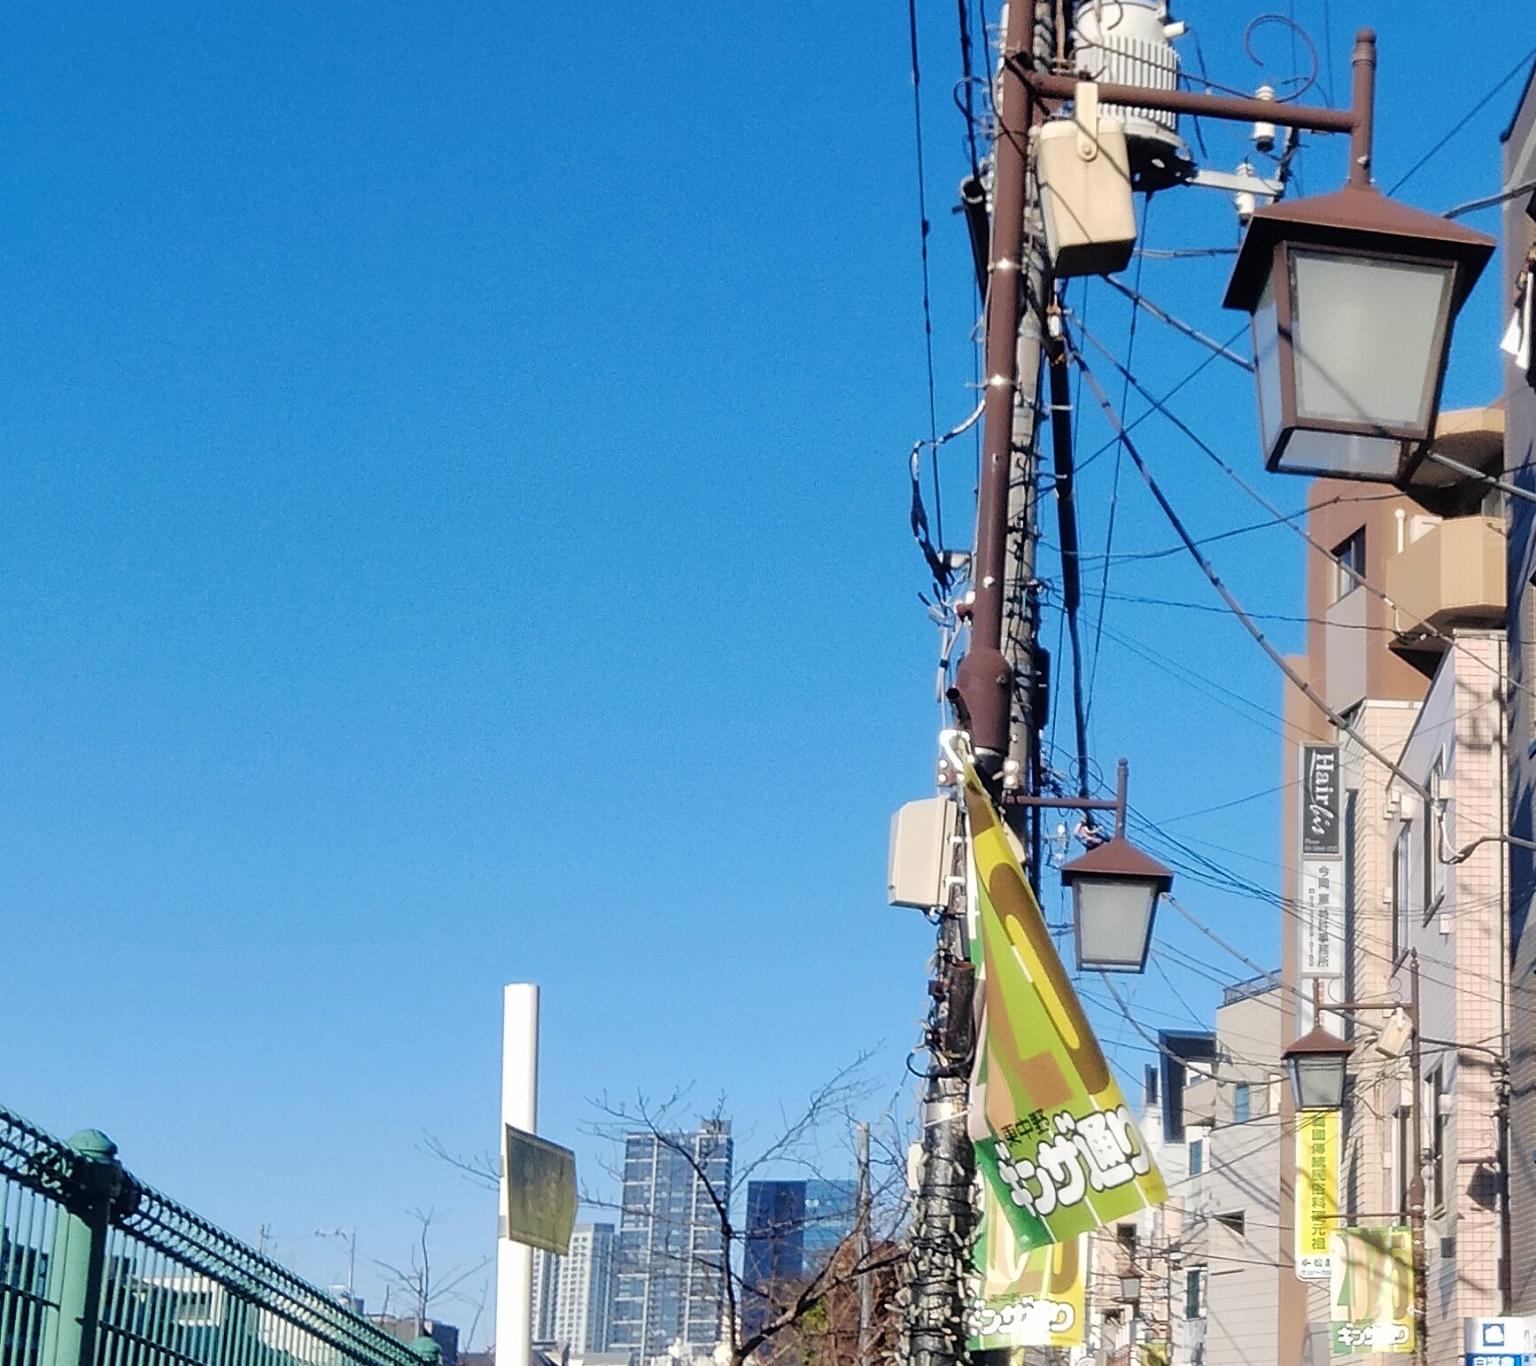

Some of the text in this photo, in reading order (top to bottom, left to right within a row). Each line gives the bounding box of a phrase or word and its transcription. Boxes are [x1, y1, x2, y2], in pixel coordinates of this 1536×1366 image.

[1315, 753, 1335, 805] Hair
[993, 1104, 1151, 1217] ギンザ通り
